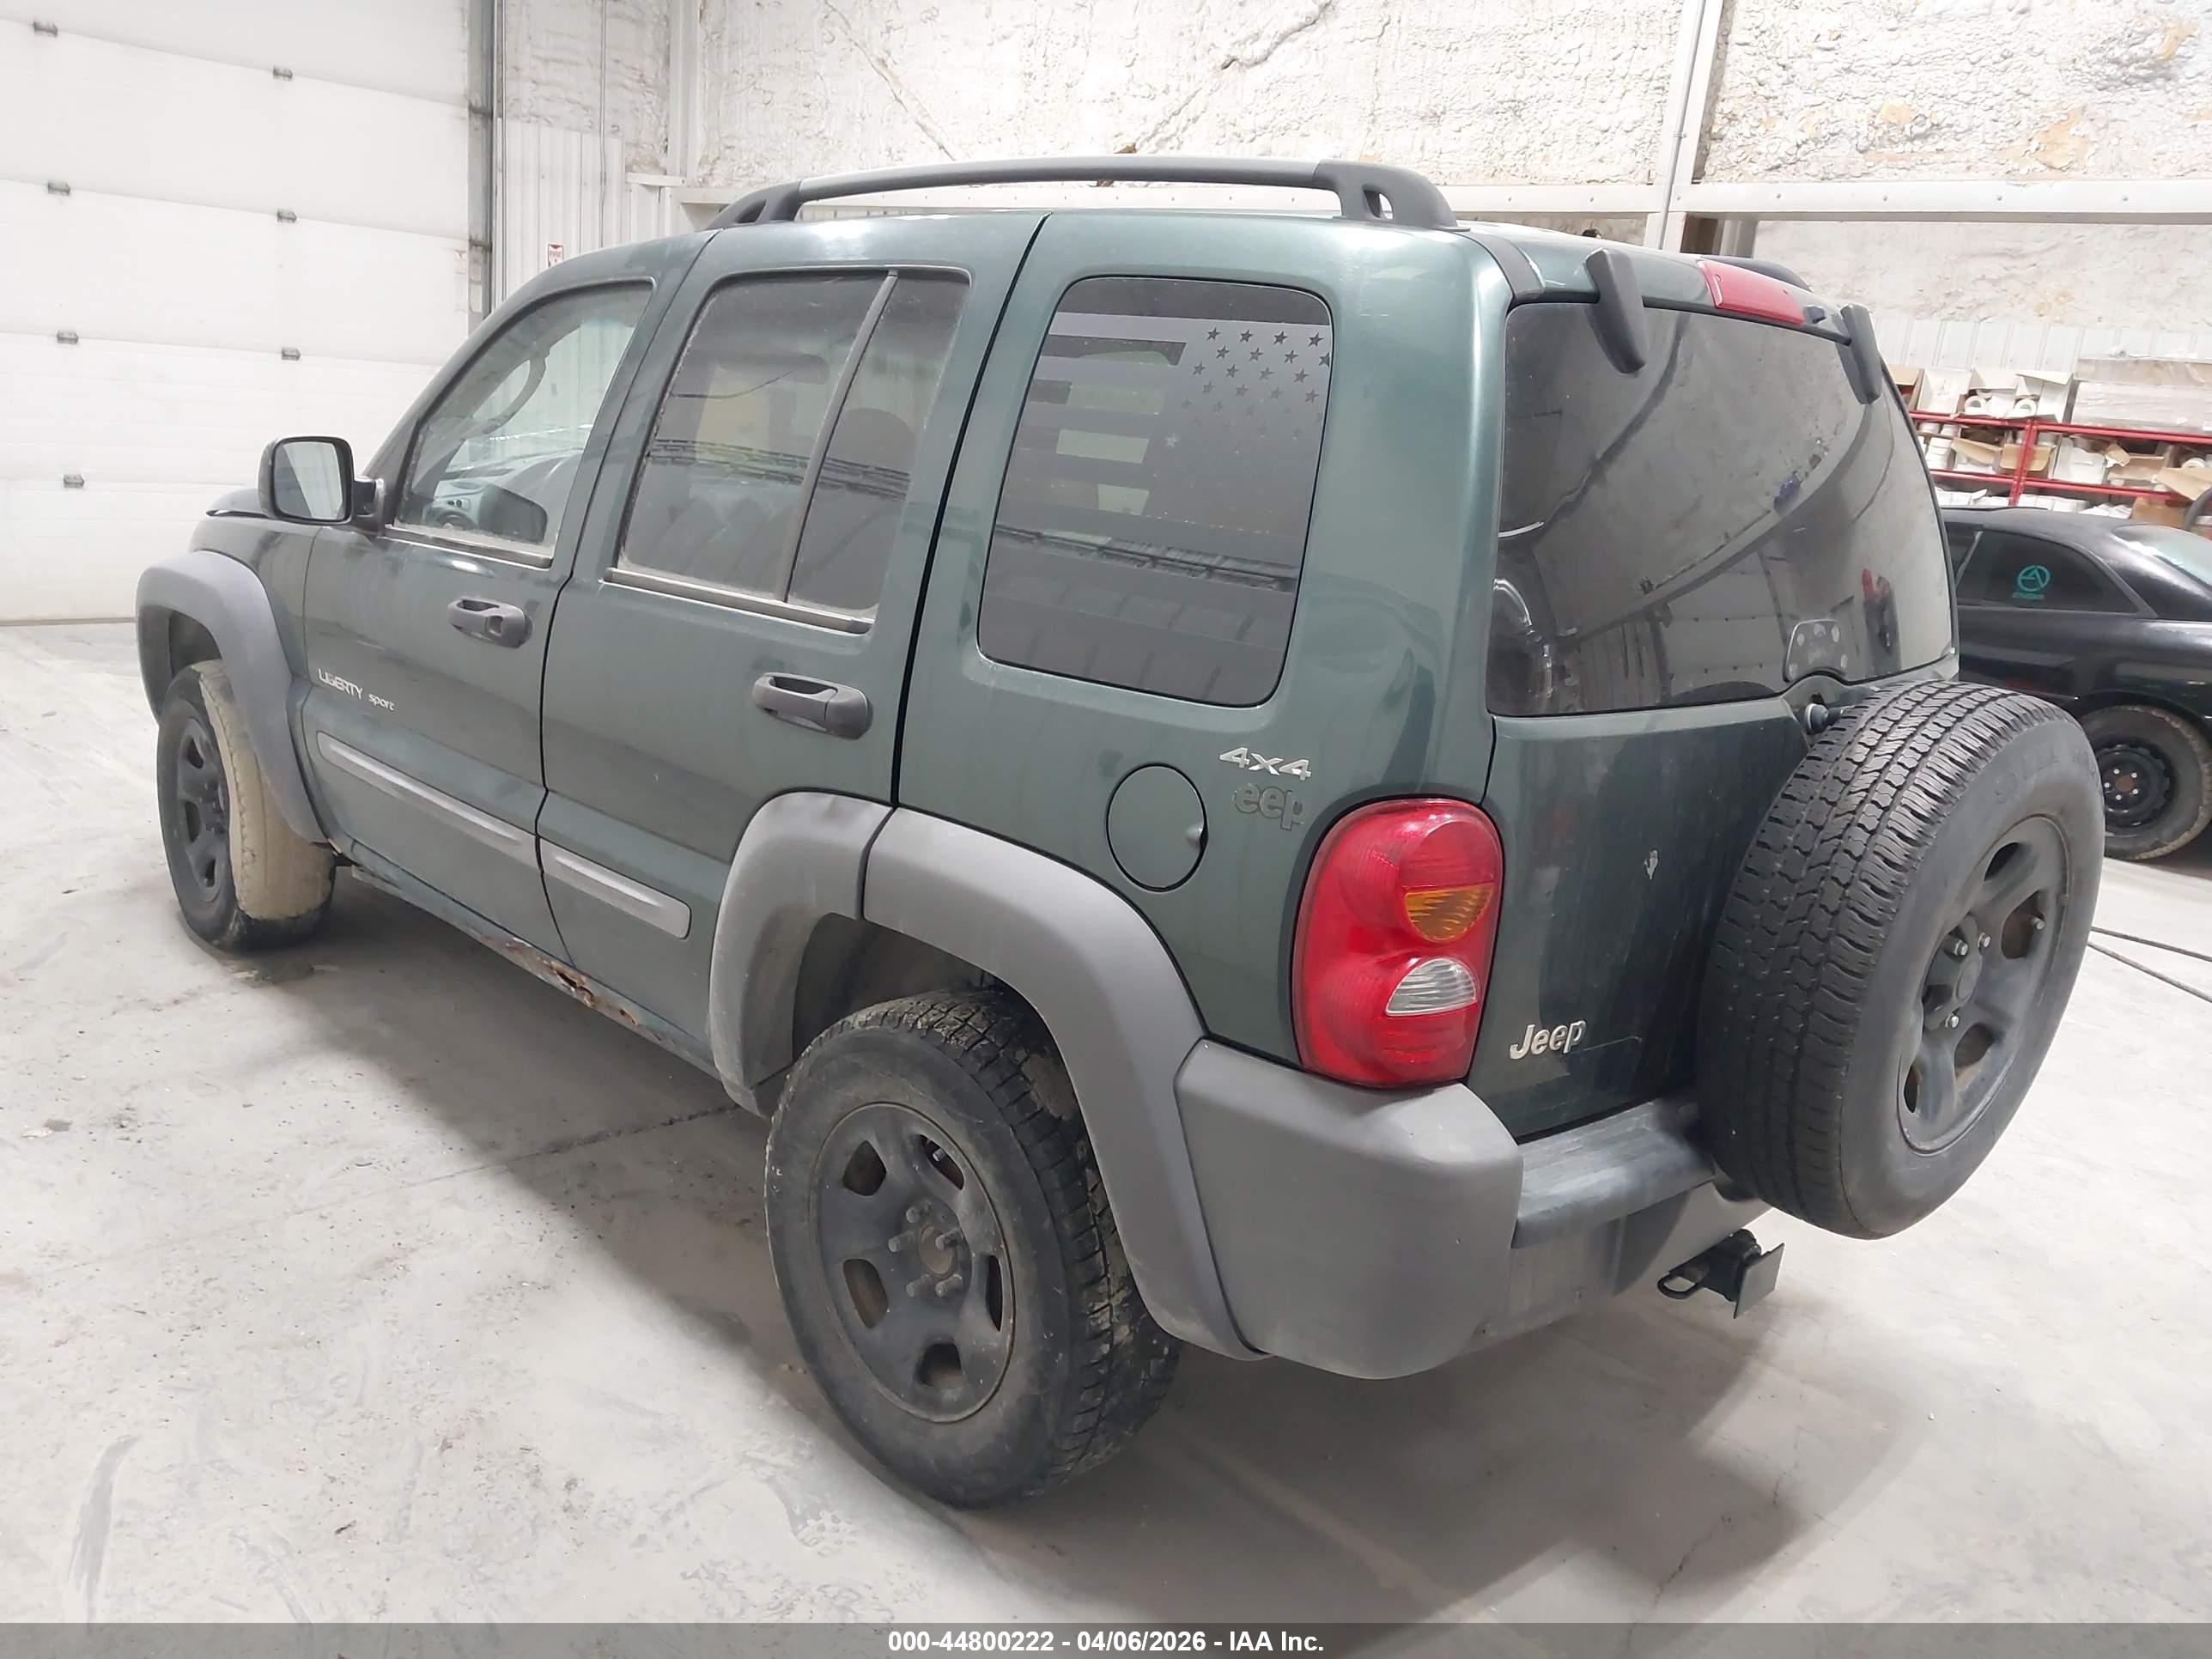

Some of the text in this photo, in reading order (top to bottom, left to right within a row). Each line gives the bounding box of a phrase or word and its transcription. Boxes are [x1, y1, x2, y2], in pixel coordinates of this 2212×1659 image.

[319, 667, 396, 712] LIBERTY sport
[1509, 1019, 1588, 1060] Jeep
